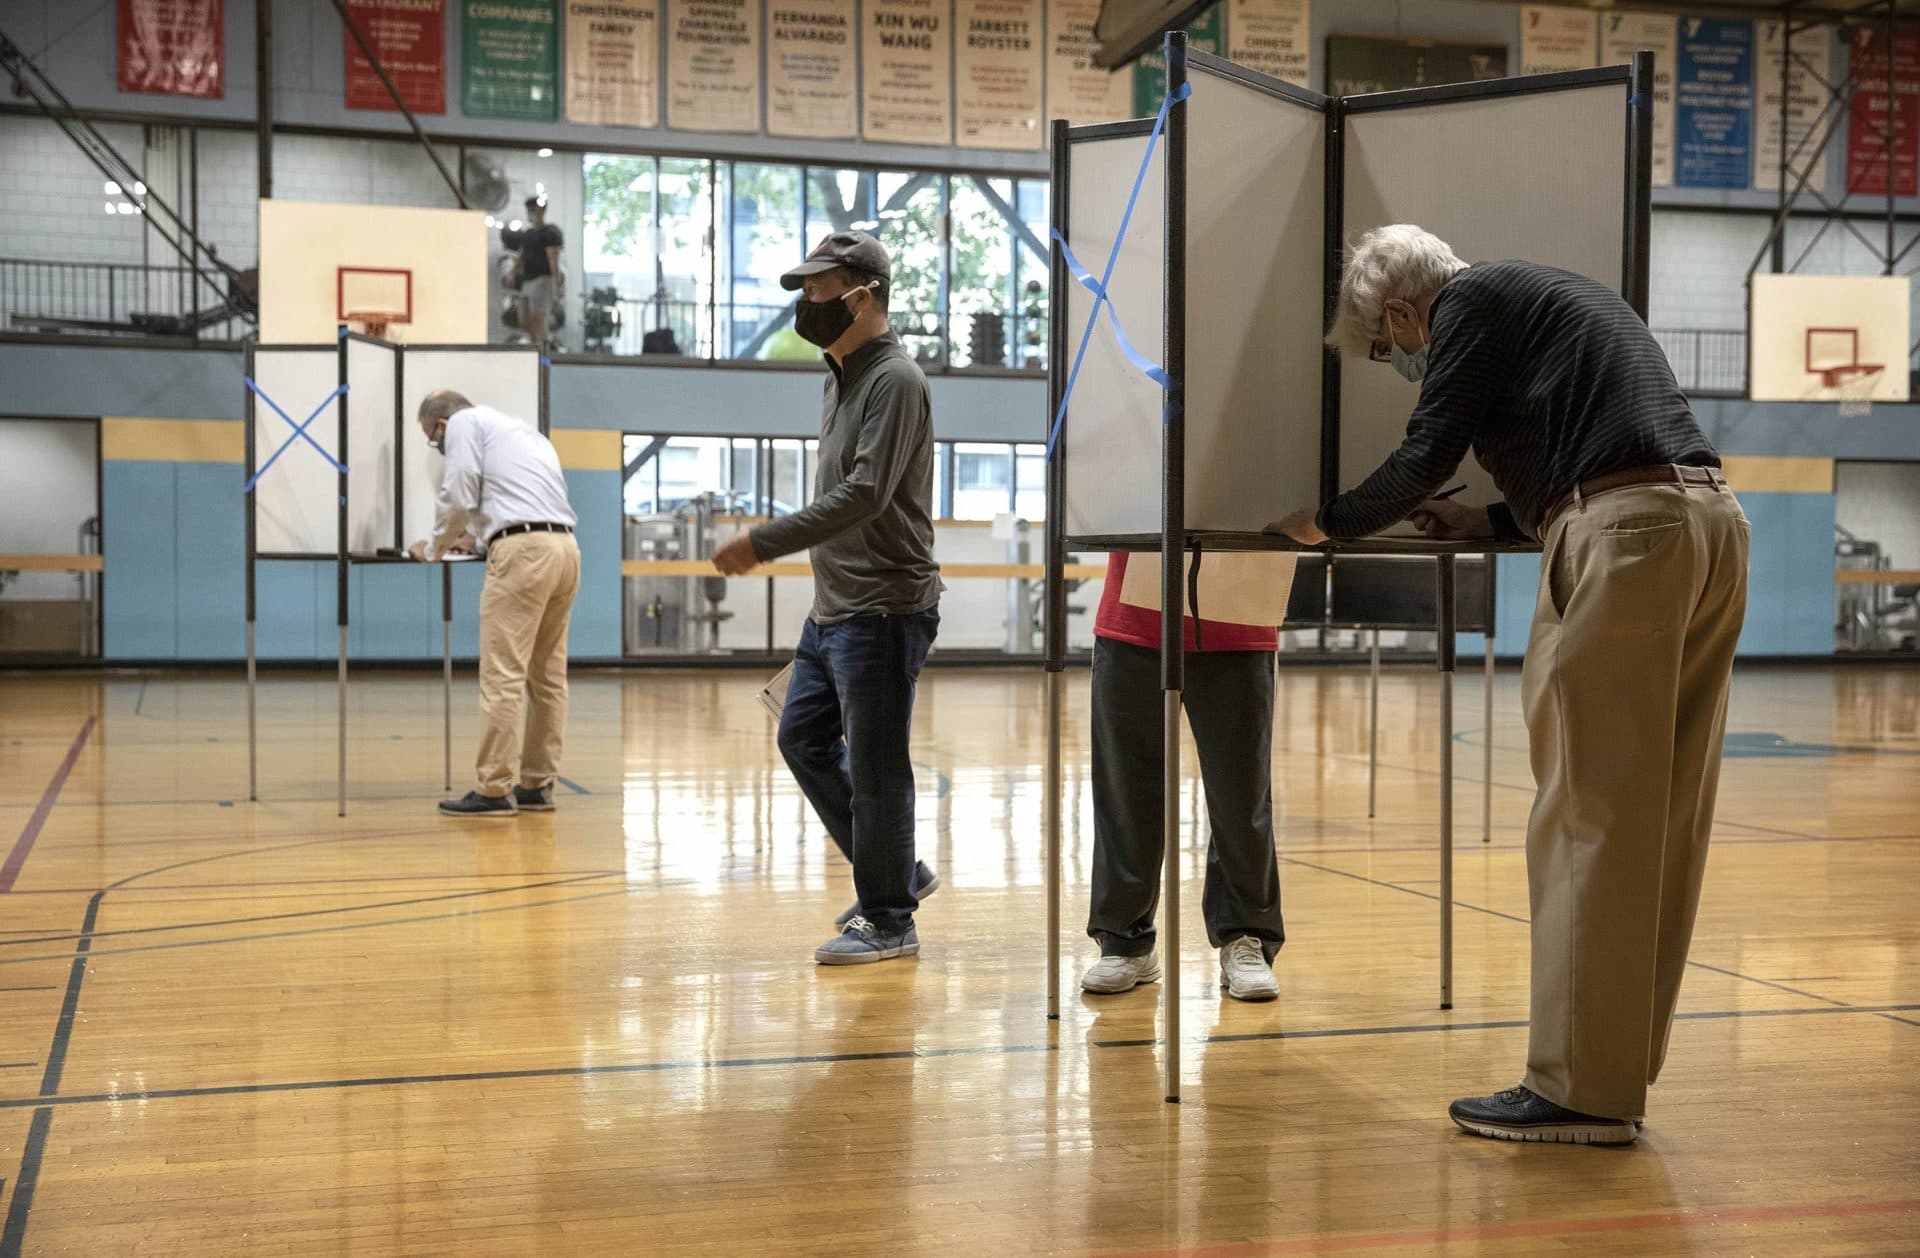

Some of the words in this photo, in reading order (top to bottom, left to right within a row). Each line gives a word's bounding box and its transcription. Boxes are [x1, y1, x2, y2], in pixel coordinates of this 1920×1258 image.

[468, 5, 553, 23] COMPANIES
[570, 4, 654, 19] CHRISTENSEN
[688, 7, 736, 19] SAVINGS
[774, 11, 847, 27] FERNANDA
[589, 22, 634, 34] FAMILY
[678, 17, 747, 32] CHARITABLE
[874, 12, 904, 28] XIN
[910, 15, 939, 31] WU
[969, 19, 1028, 33] JARRETT
[675, 30, 751, 45] FOUNDATION
[775, 28, 846, 43] ALVARADO
[880, 32, 932, 49] WANG
[968, 34, 1030, 49] ROYSTER
[1244, 36, 1292, 48] CHINESE
[1232, 48, 1305, 63] BENEVOLENT
